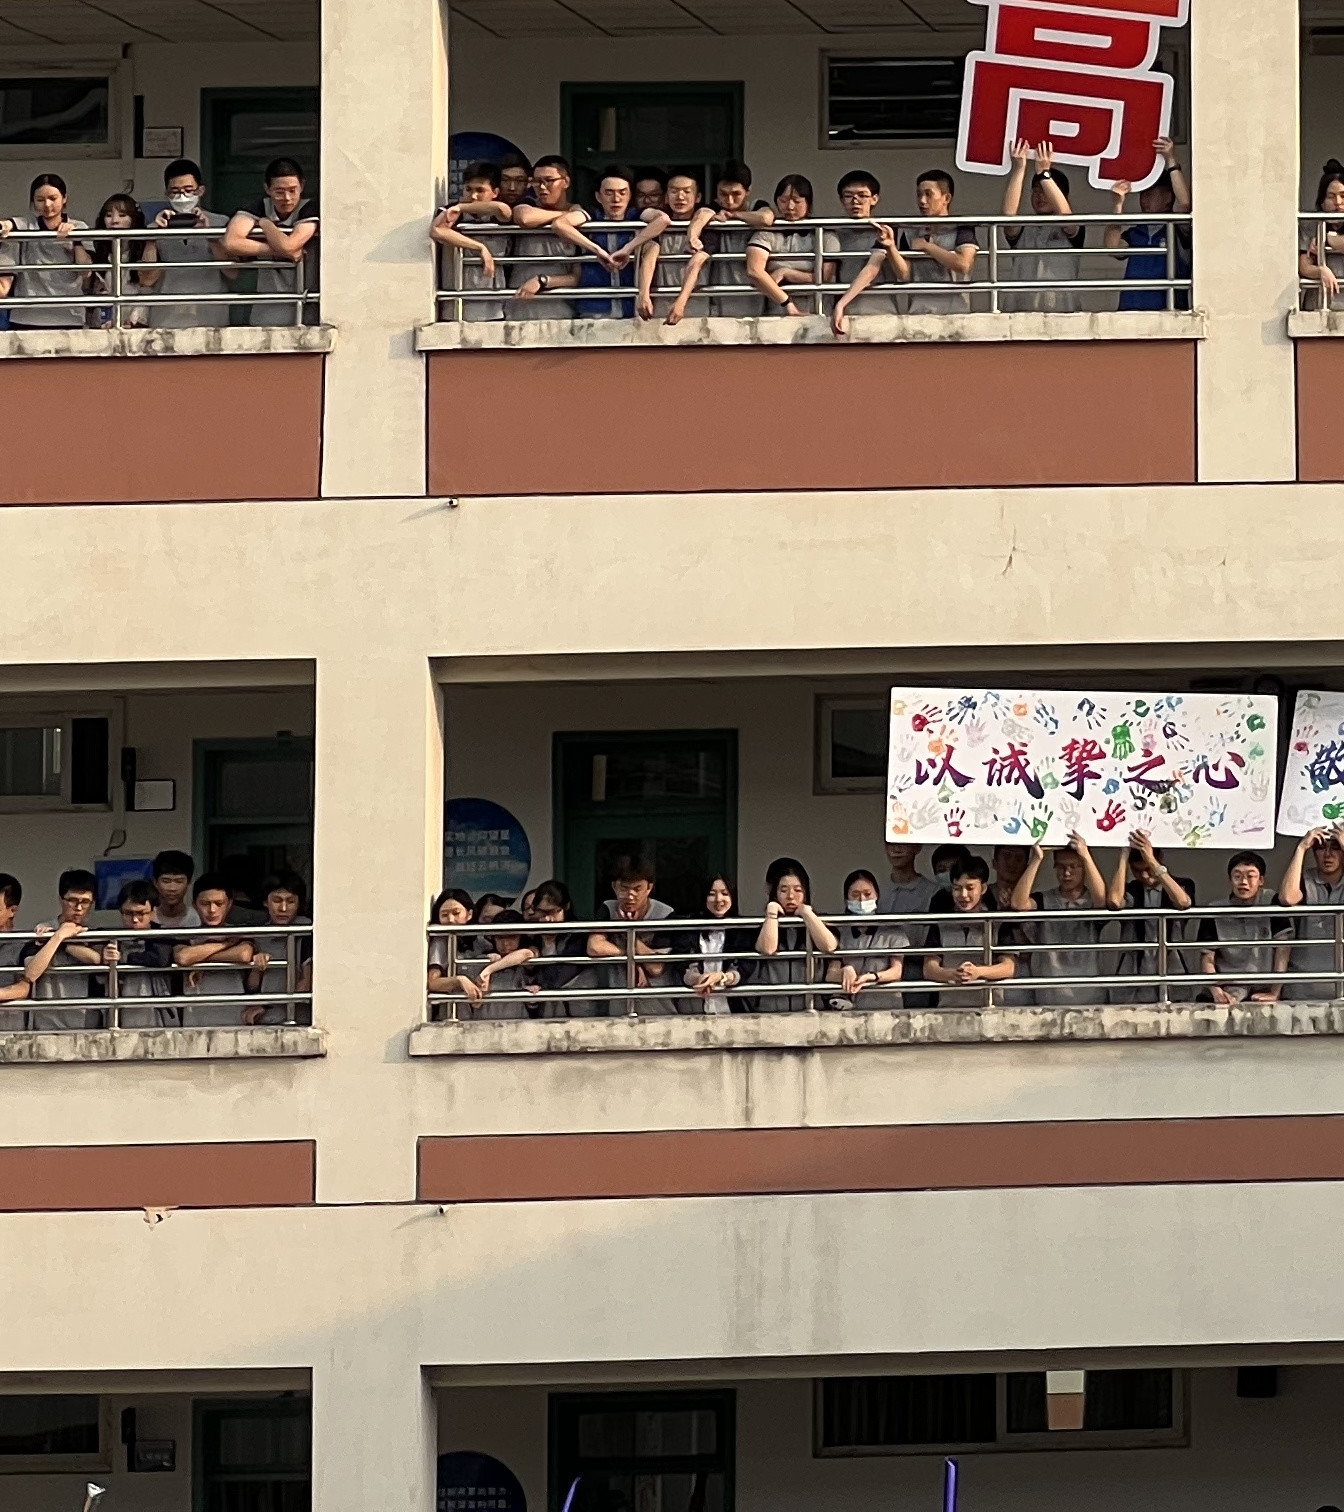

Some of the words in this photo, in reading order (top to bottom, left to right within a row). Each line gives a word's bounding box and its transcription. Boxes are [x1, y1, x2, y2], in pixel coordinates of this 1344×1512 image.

[914, 737, 1246, 802] 以诚挚之心
